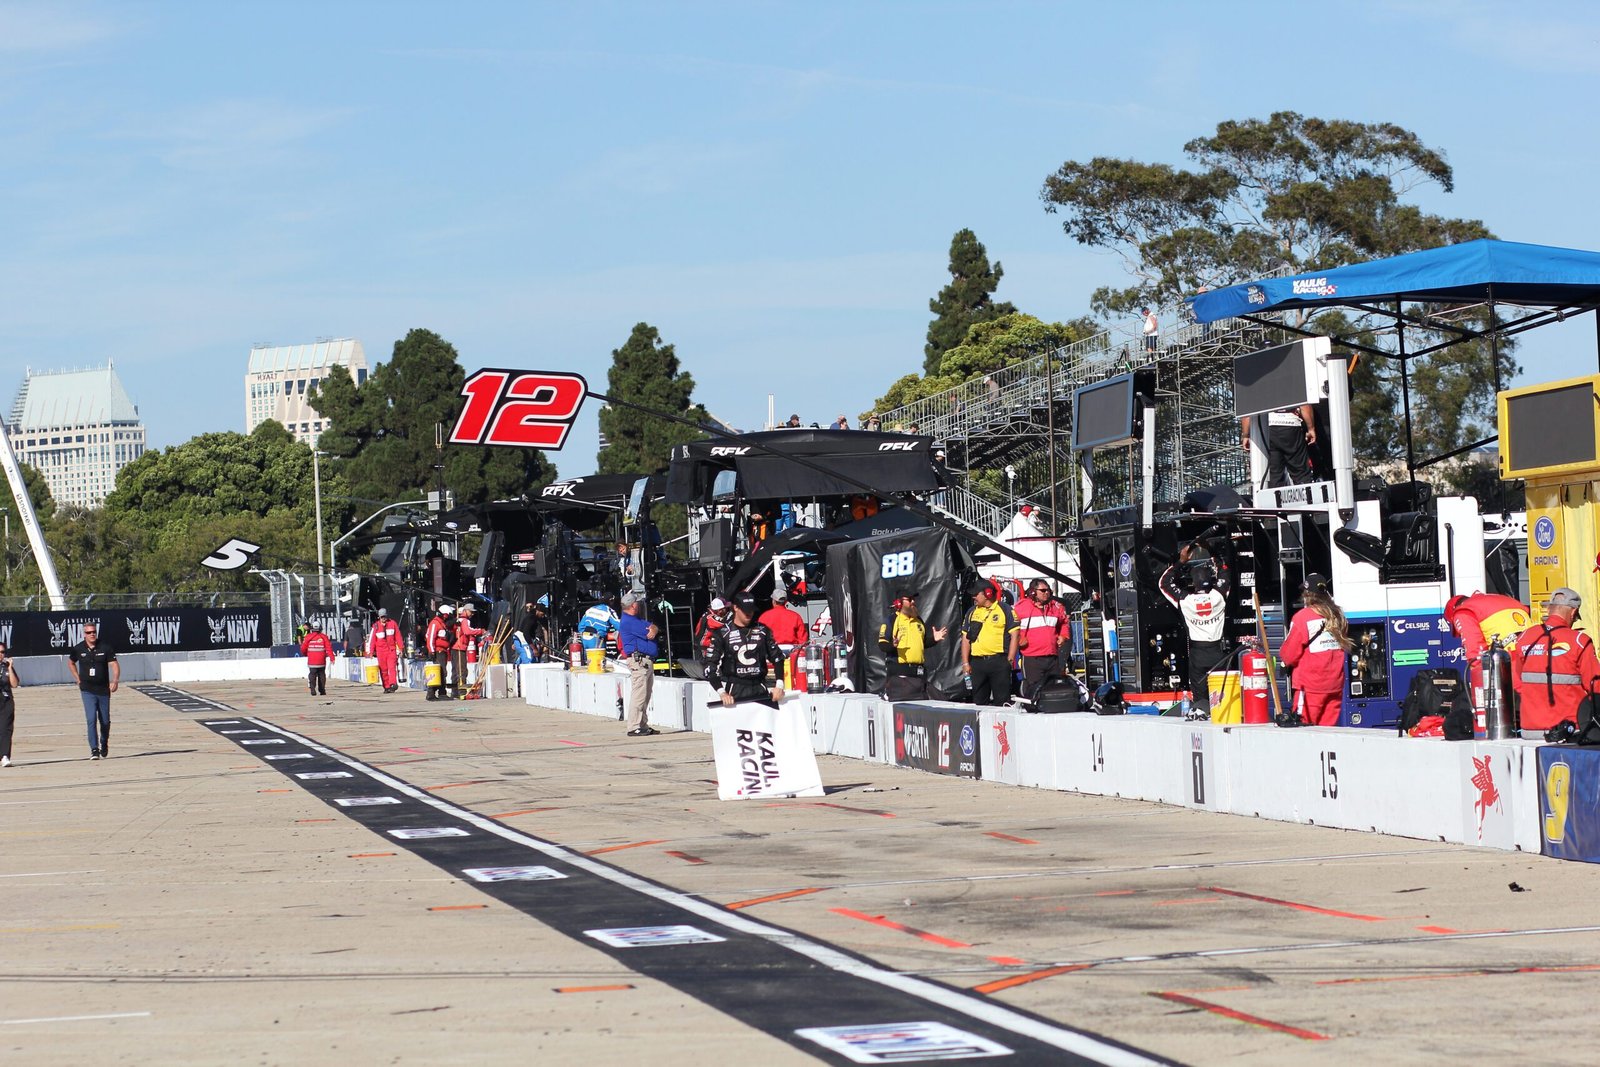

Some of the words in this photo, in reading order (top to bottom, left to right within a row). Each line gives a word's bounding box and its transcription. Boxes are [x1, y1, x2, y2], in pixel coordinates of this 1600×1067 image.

[1292, 278, 1327, 287] KAULIG
[1293, 286, 1328, 294] RACING
[449, 371, 586, 448] 12
[710, 447, 751, 456] RFK
[541, 484, 577, 497] RFK
[201, 539, 260, 569] 5
[881, 550, 915, 579] 88
[1534, 556, 1559, 565] RACING
[147, 621, 181, 644] NAVY
[227, 619, 259, 643] NAVY
[937, 722, 950, 769] 12
[1091, 733, 1104, 772] 14
[756, 731, 780, 788] KAUL
[959, 763, 975, 772] RACIN
[1320, 750, 1338, 800] 15
[1545, 762, 1571, 844] 9
